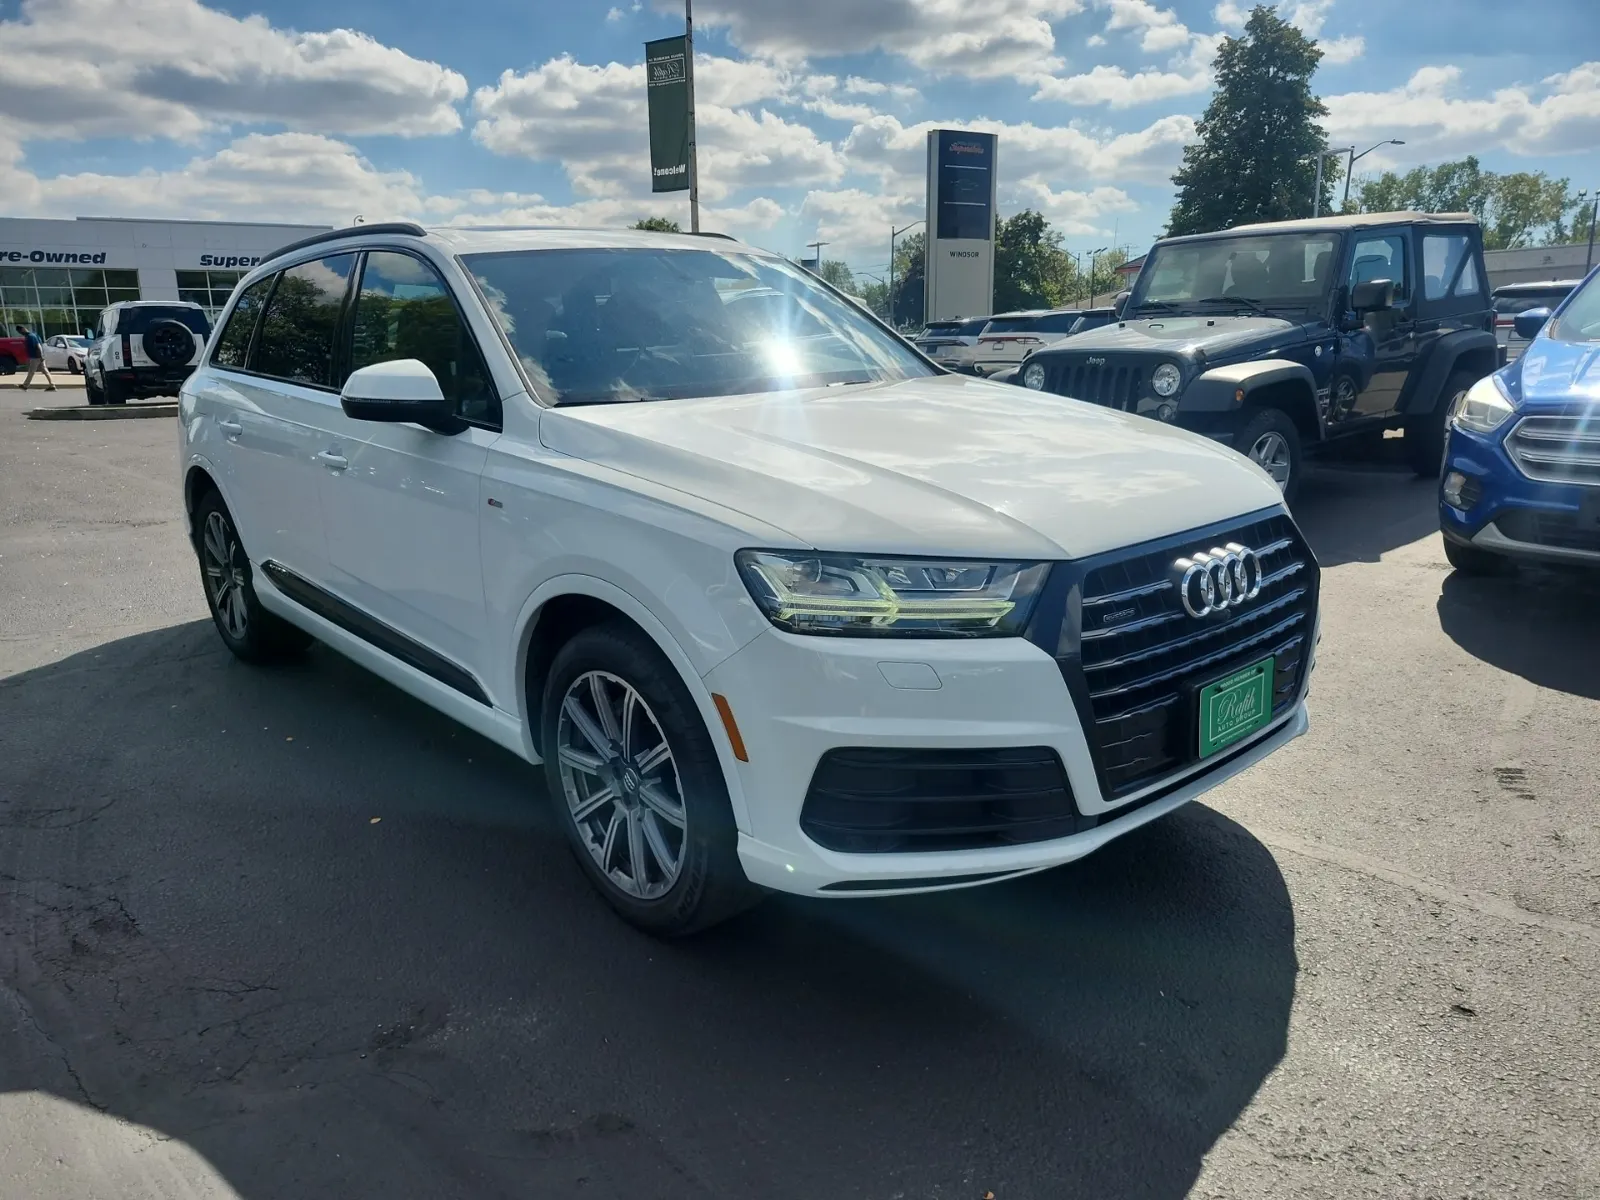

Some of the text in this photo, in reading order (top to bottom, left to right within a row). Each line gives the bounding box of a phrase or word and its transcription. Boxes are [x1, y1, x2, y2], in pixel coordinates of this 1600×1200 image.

[1086, 356, 1106, 366] Jeep
[1217, 687, 1256, 725] Rafih
[1217, 708, 1256, 733] AUTO GROUP
